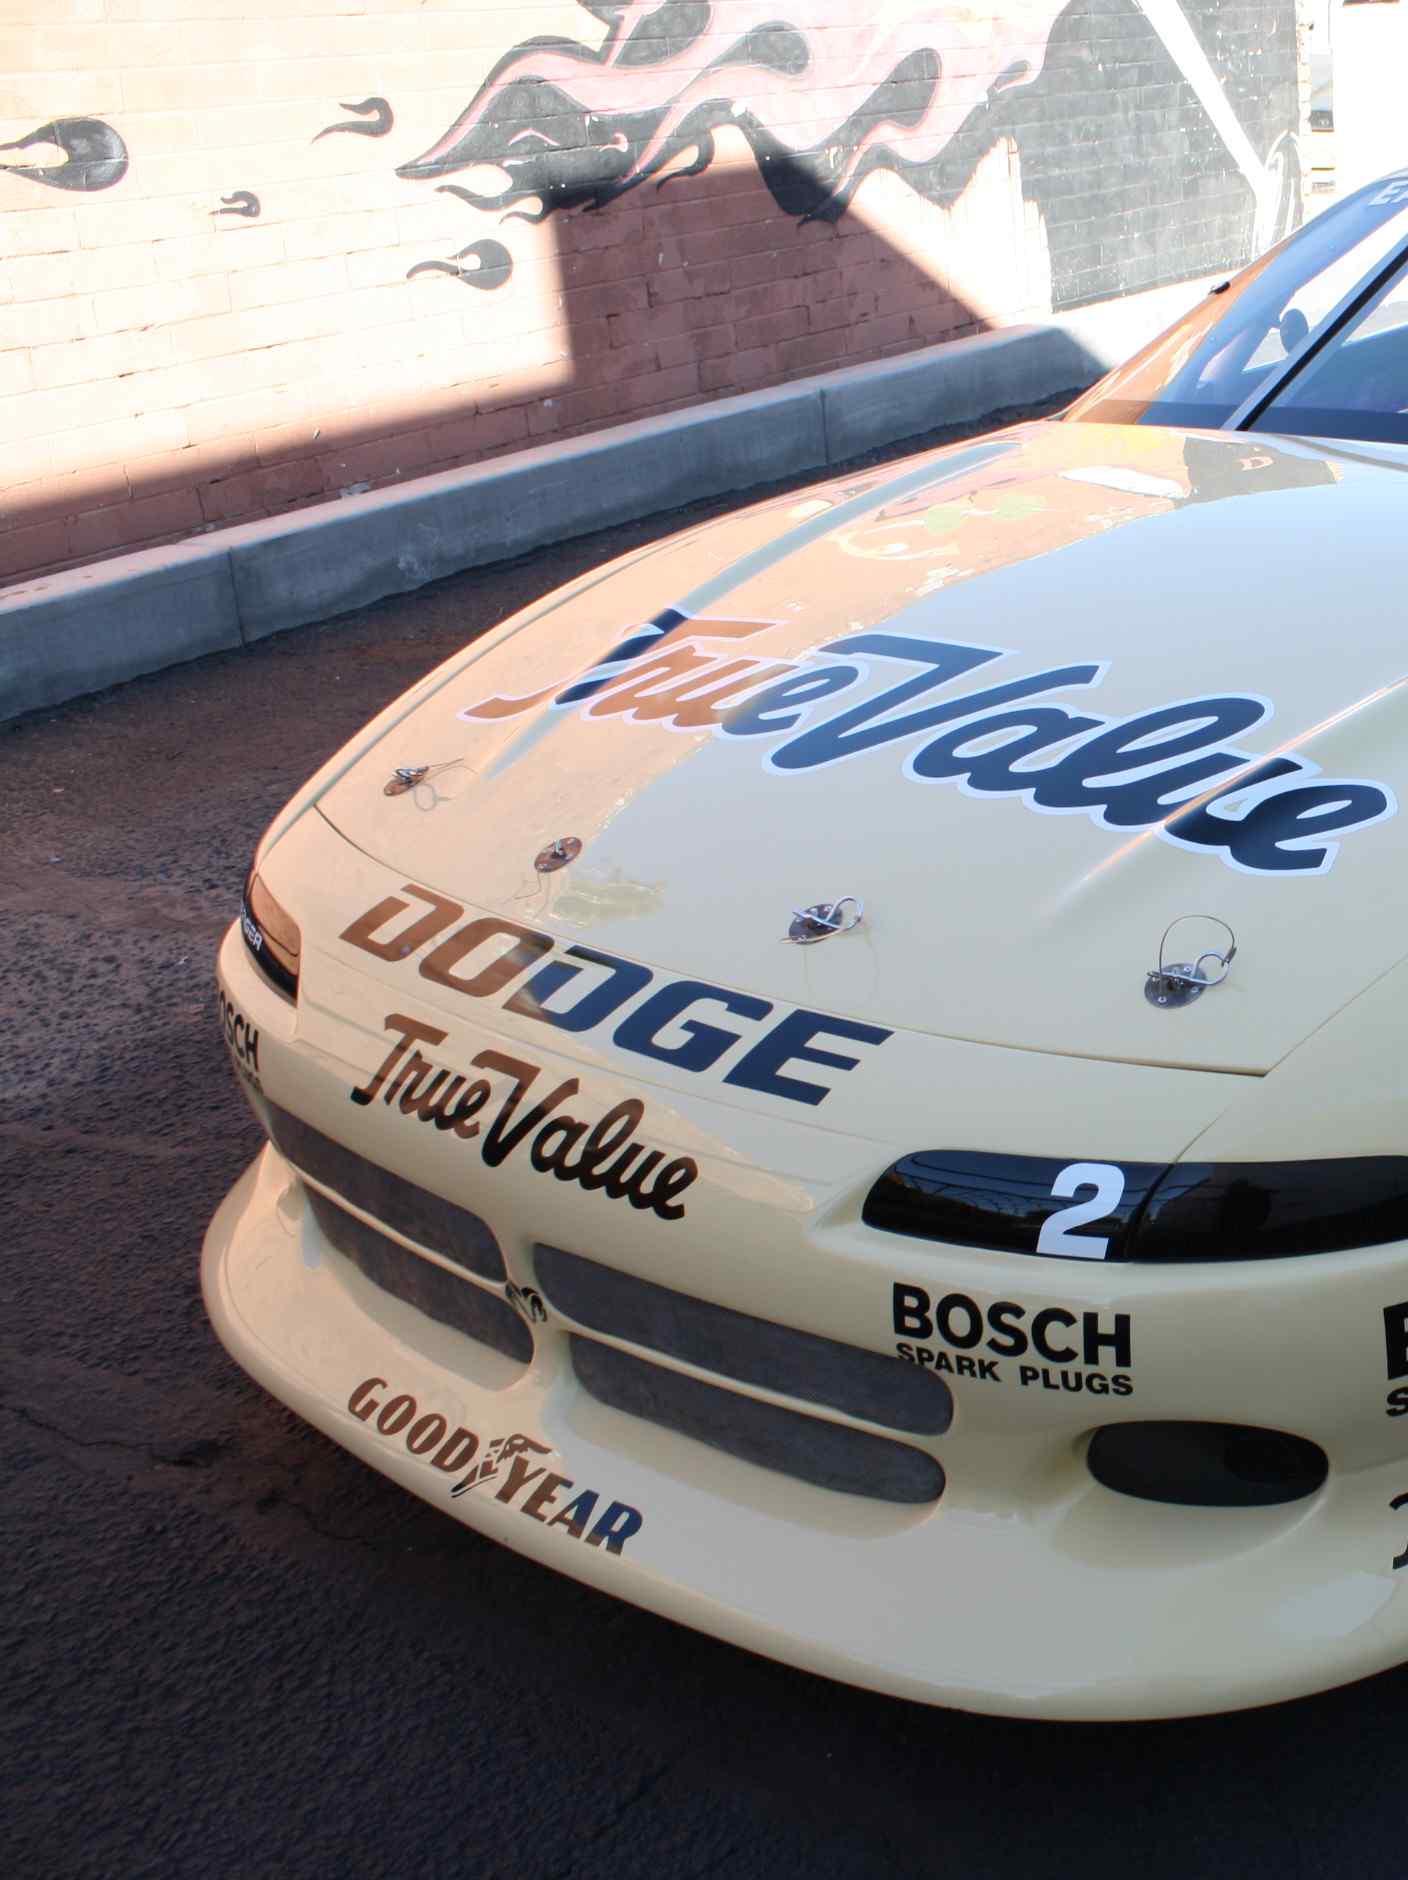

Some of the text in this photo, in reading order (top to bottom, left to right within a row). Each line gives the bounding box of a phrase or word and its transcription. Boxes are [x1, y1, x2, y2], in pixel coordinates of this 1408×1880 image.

[338, 882, 895, 1106] DODGE
[350, 1011, 699, 1221] True Value
[1036, 1161, 1128, 1261] 2
[892, 1281, 1133, 1368] BOSCH
[895, 1342, 1135, 1397] SPARK PLUGS
[348, 1376, 644, 1556] GOODYEAR
